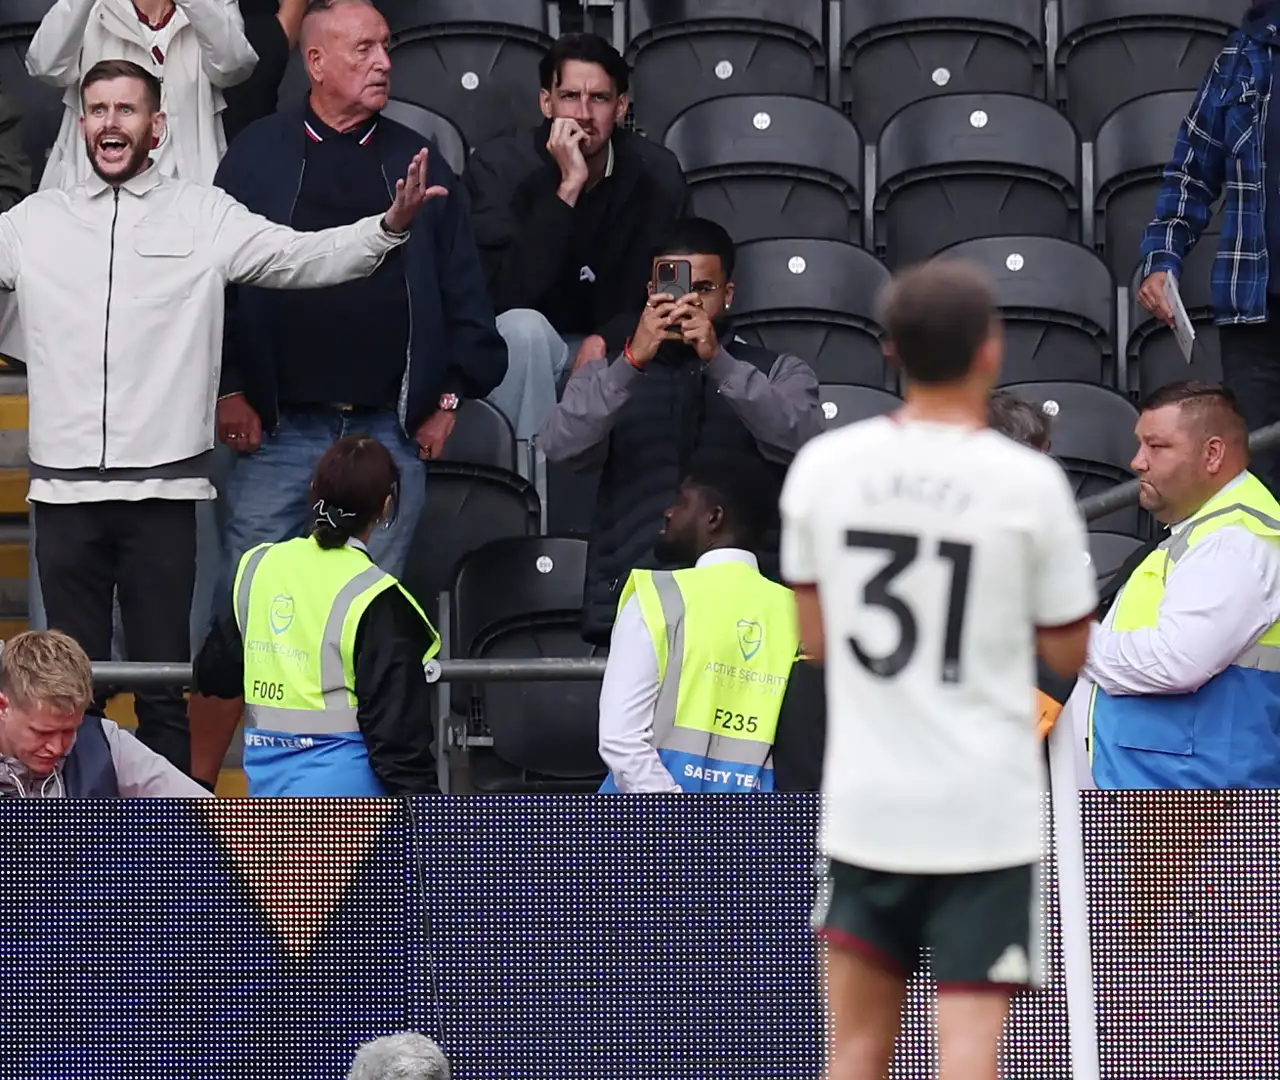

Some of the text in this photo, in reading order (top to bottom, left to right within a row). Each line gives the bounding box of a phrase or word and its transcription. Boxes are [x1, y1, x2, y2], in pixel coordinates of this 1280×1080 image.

[845, 530, 974, 685] 31
[704, 661, 737, 677] ACTIVE
[252, 680, 285, 701] F005
[713, 708, 759, 733] F235
